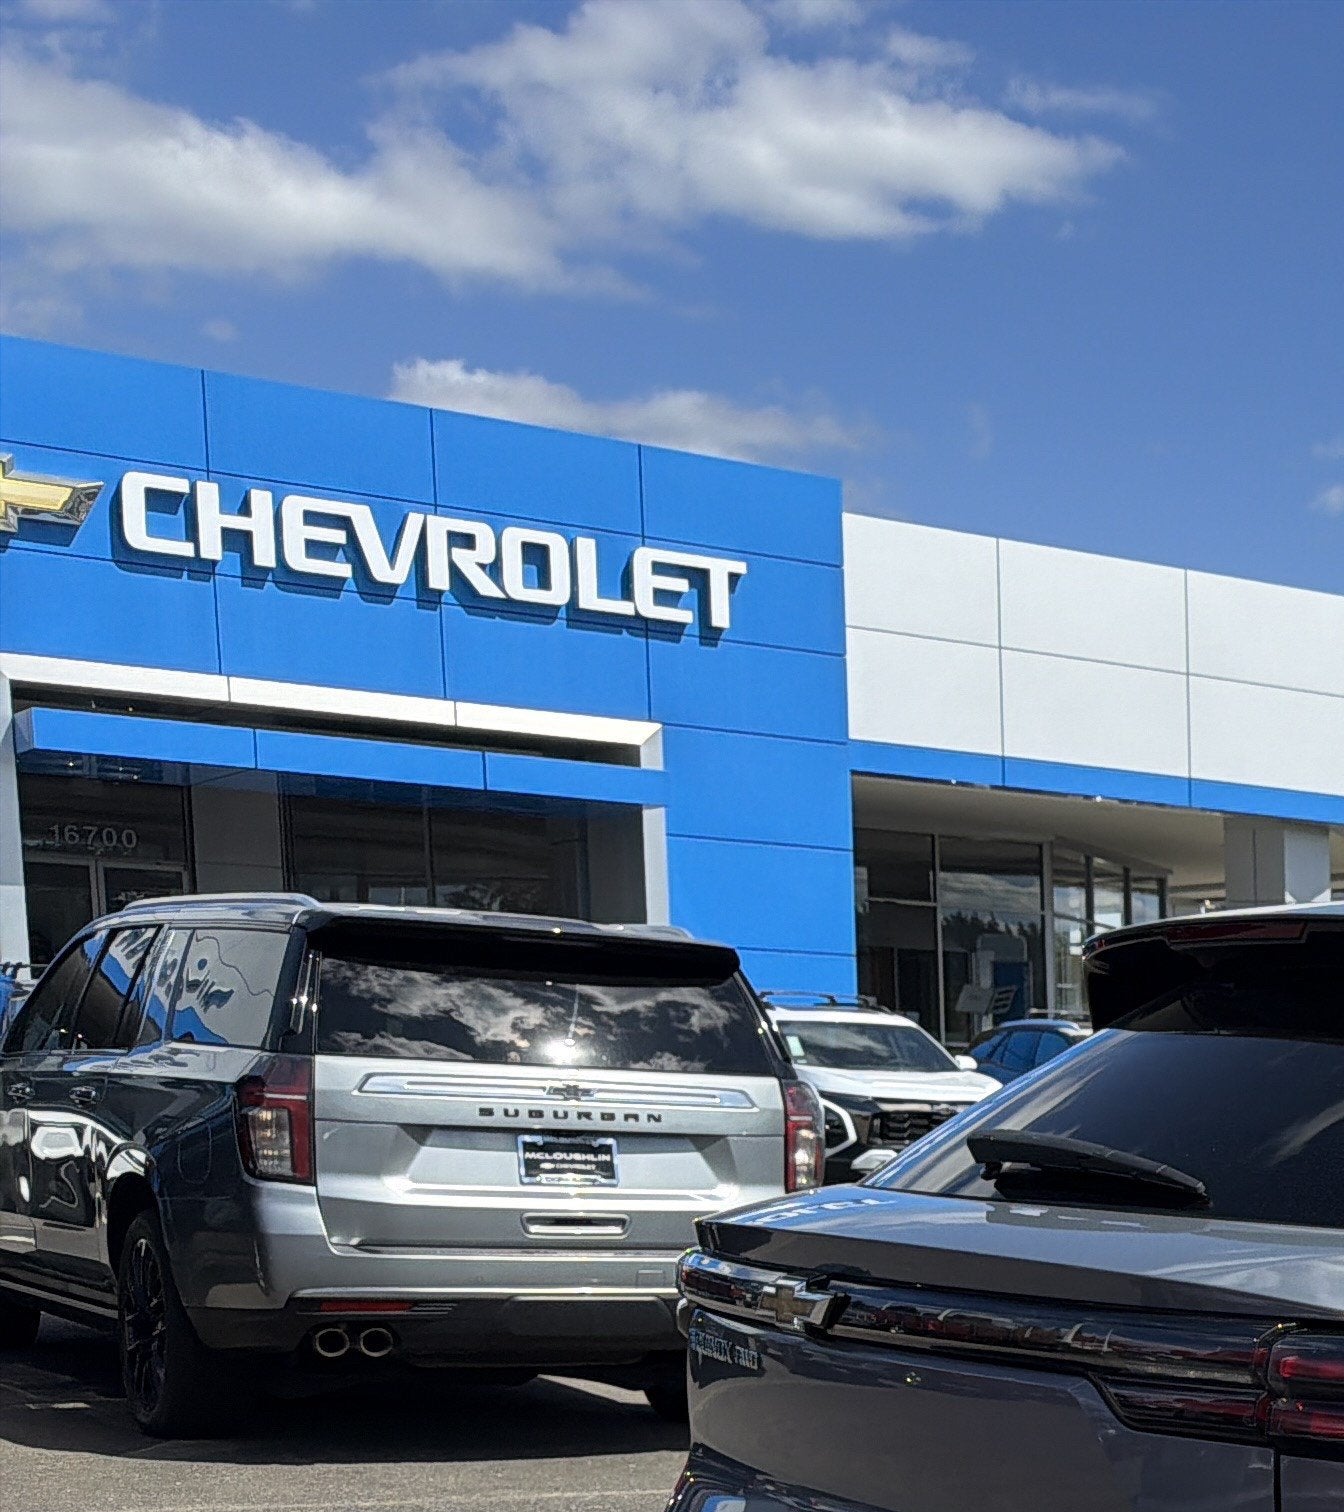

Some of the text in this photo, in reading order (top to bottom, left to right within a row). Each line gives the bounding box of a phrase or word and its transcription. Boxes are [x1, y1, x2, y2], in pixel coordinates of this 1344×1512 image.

[120, 471, 747, 630] CHEVROLET
[49, 824, 138, 849] 16700
[478, 1107, 663, 1123] SUBURBAN
[525, 1151, 611, 1162] MCLOUGHLIN
